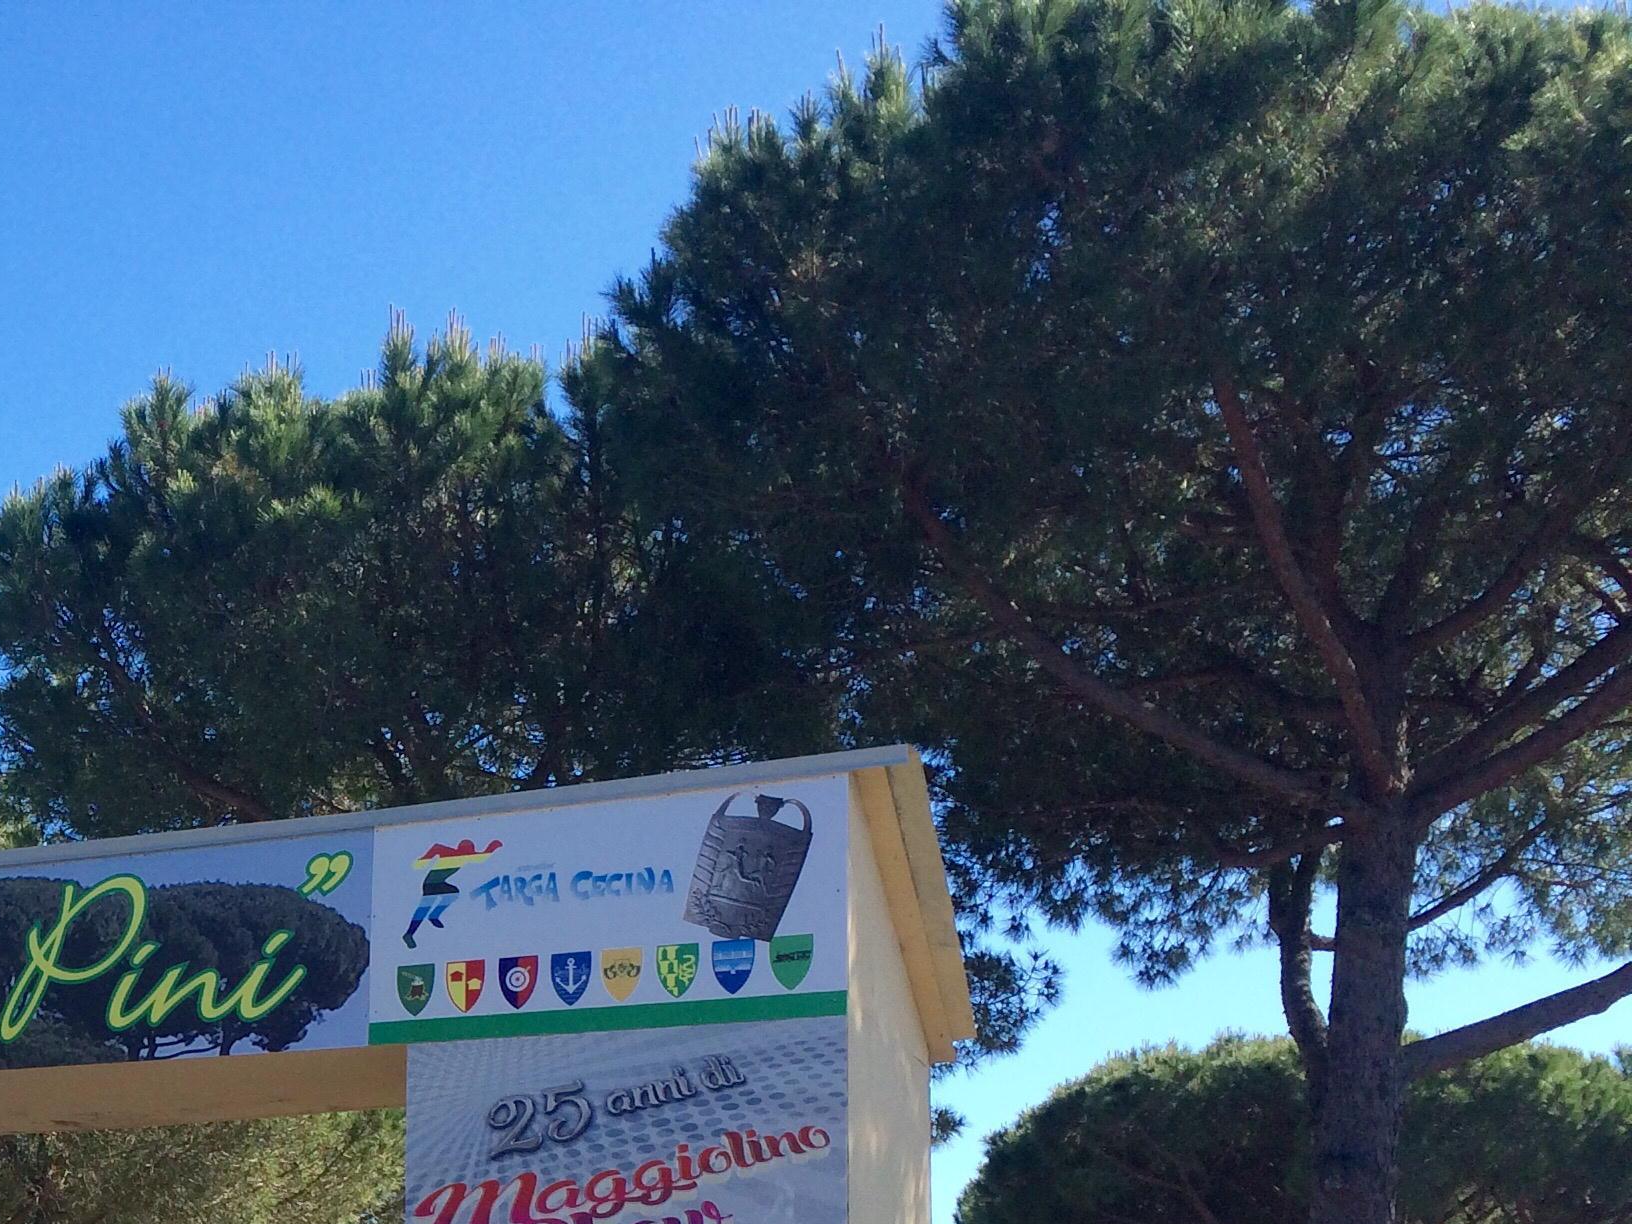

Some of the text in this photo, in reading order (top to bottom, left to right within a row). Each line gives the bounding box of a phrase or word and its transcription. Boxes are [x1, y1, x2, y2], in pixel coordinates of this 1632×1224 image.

[468, 866, 674, 911] TARGA CECINA
[488, 1053, 745, 1160] 25 anni di
